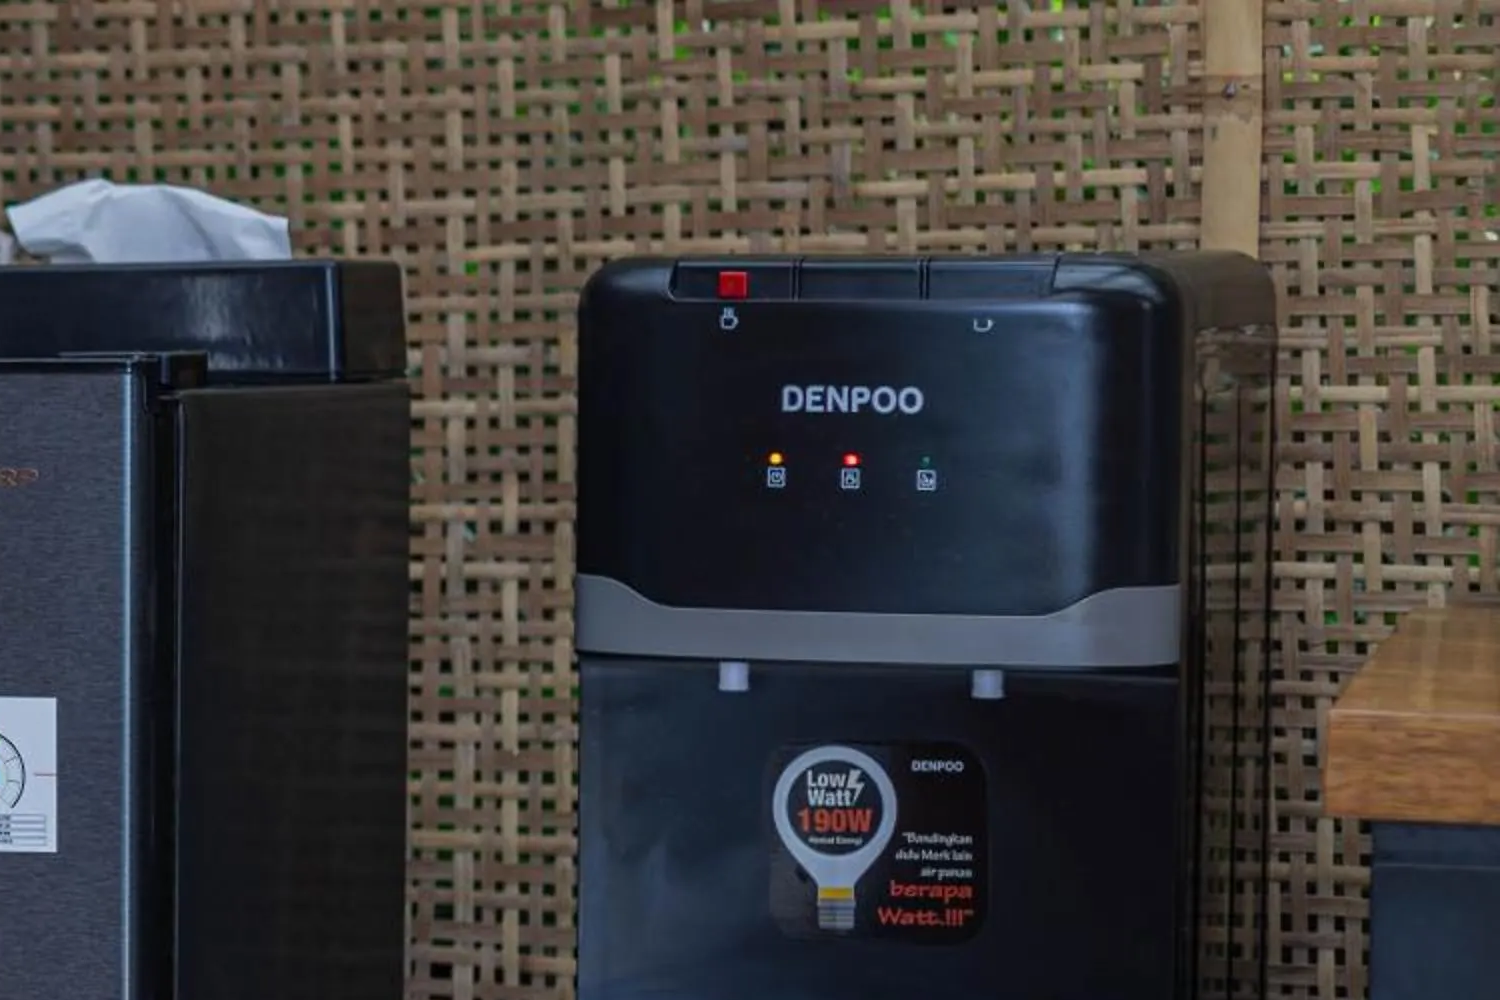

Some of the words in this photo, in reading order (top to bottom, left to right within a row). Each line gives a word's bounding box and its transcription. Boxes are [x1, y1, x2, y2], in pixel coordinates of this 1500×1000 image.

[781, 384, 925, 415] DENPOO
[911, 760, 965, 772] DENPOO
[807, 770, 847, 788] Low
[808, 788, 852, 807] Watt
[797, 808, 872, 834] 190W
[890, 879, 973, 904] berapa
